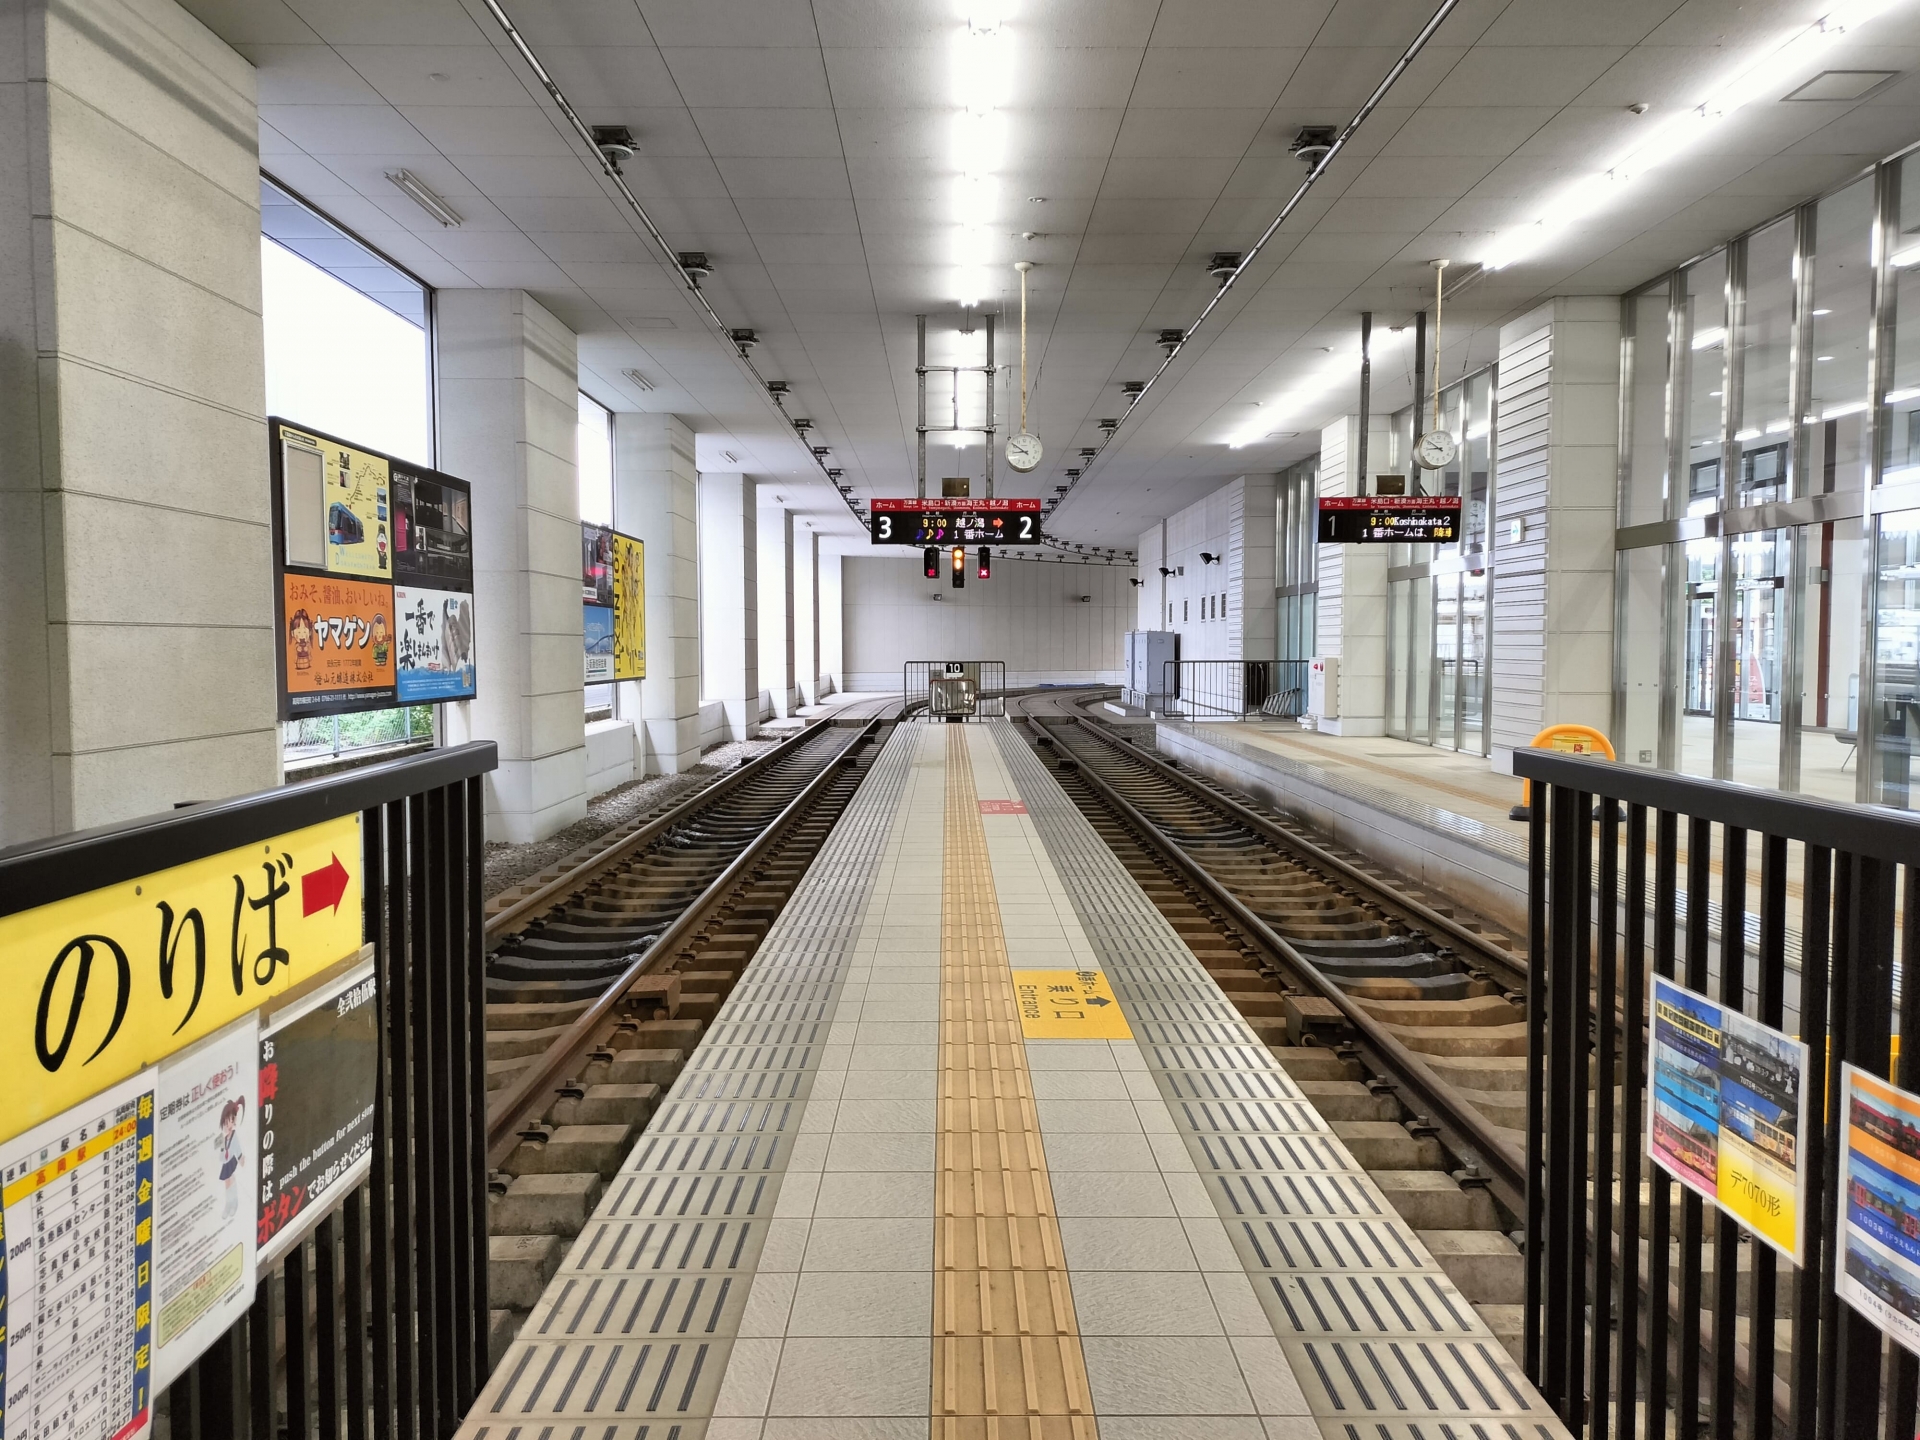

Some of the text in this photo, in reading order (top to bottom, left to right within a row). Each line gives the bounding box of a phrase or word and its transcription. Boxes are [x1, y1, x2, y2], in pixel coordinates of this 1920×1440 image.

[879, 516, 892, 539] 3
[922, 518, 947, 528] 9:00
[955, 517, 985, 529] 越ノ潟
[1020, 516, 1033, 539] 2
[1328, 515, 1336, 536] 1
[1370, 517, 1394, 526] 9:00
[314, 614, 371, 650] ヤマゲン
[949, 664, 960, 673] 10
[34, 852, 295, 1074] のりば
[1018, 984, 1041, 1019] Entrance
[1046, 985, 1085, 1019] 乗り口
[279, 1165, 298, 1190] push
[299, 1156, 311, 1172] the
[312, 1137, 335, 1161] button
[336, 1127, 347, 1143] for
[347, 1114, 361, 1133] next
[1730, 1169, 1781, 1217] デ7070形
[9, 1237, 32, 1260] 200円
[9, 1322, 32, 1347] 250円
